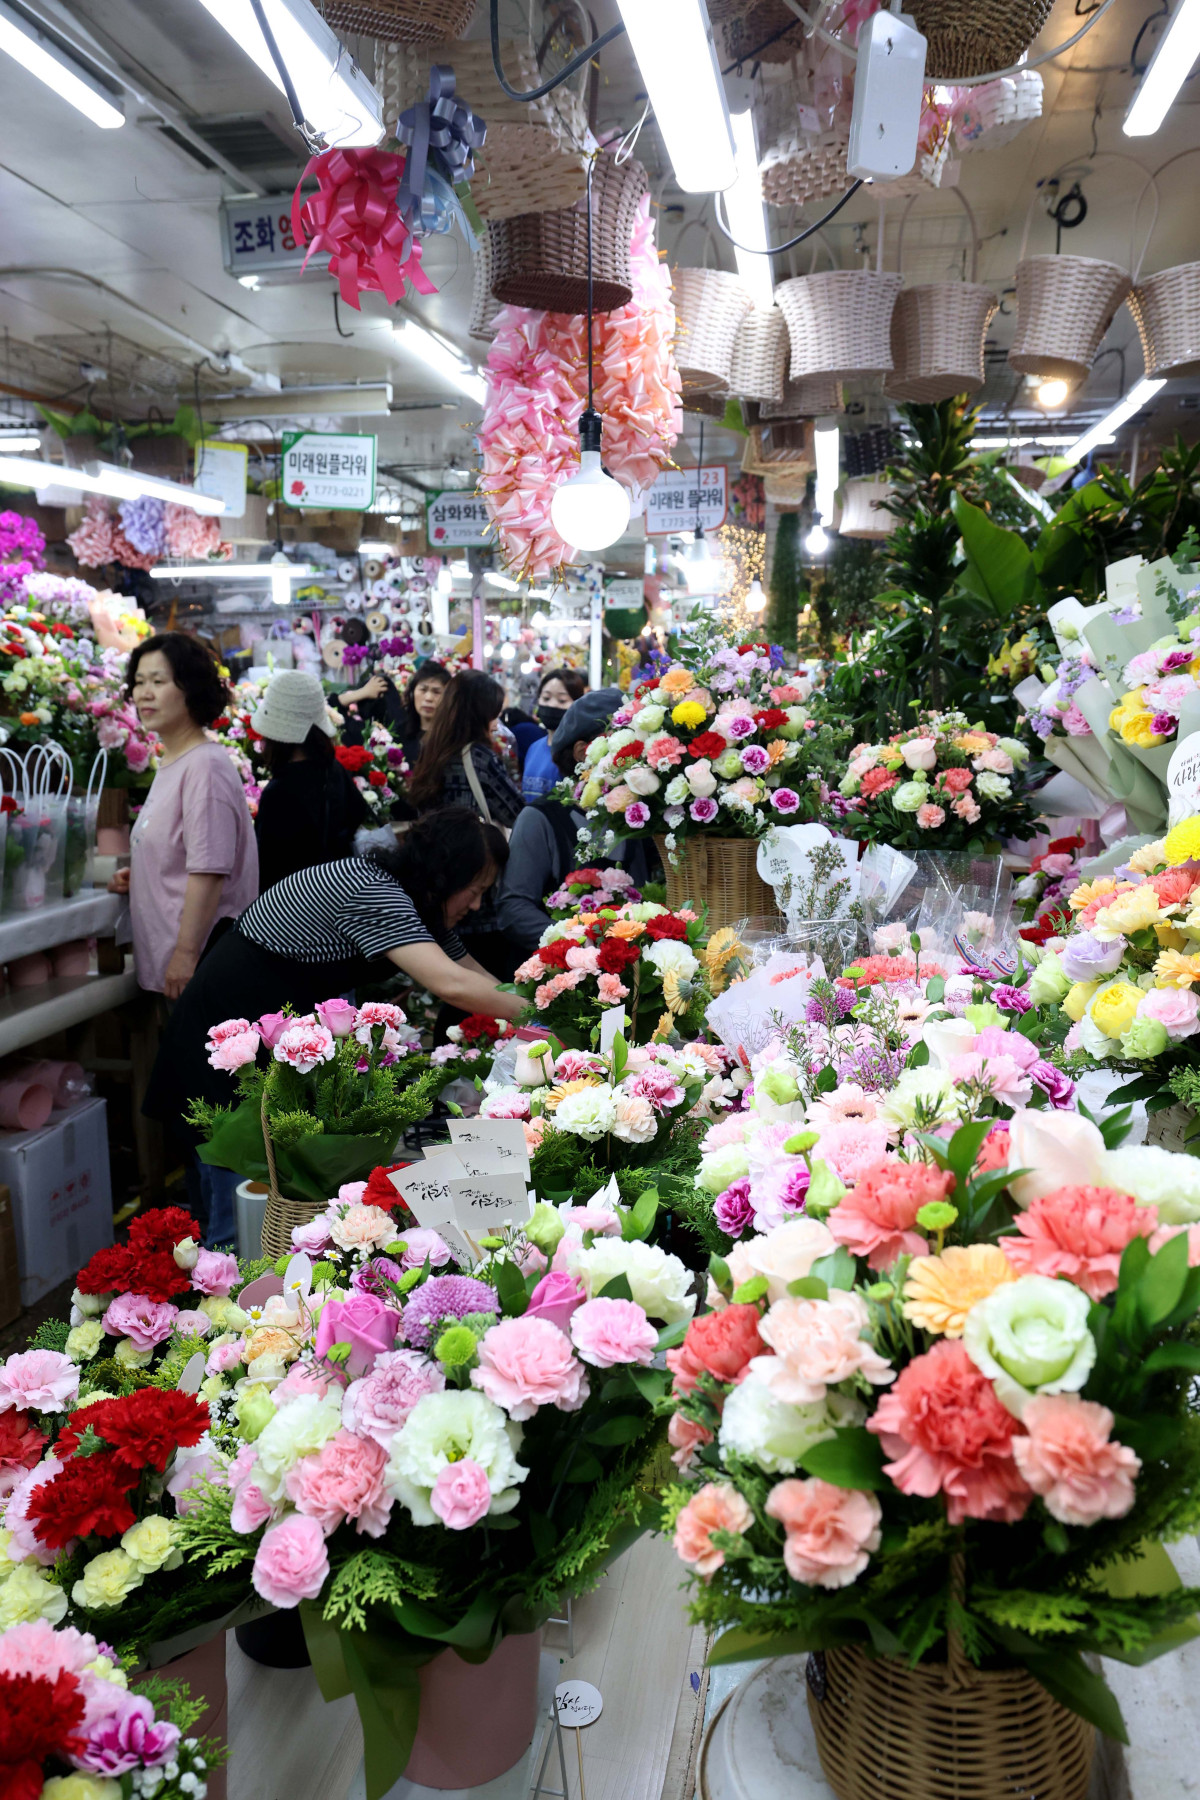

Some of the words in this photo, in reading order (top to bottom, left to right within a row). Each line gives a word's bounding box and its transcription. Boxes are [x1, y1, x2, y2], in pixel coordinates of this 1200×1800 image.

[234, 215, 275, 253] 조화
[289, 452, 367, 476] 미래원플라워
[702, 471, 720, 486] 23
[649, 490, 684, 510] 미래원
[687, 488, 723, 508] 플라워
[1174, 762, 1200, 787] 사랑
